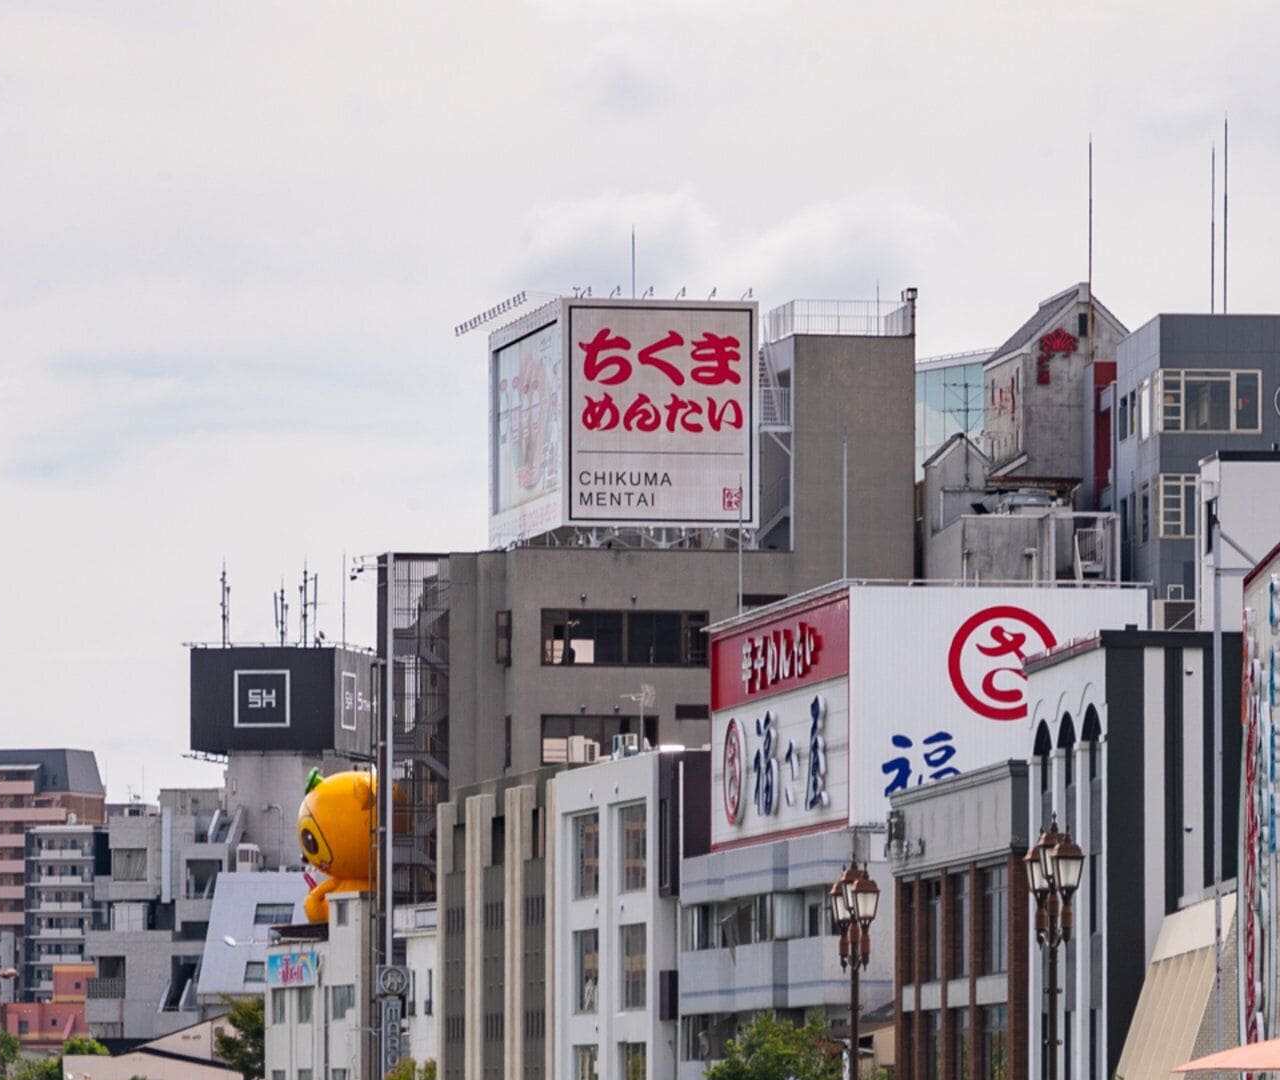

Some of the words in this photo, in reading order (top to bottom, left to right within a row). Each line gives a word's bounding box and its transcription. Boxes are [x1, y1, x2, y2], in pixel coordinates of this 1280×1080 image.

[578, 327, 743, 387] ちくま
[580, 393, 745, 433] めんたい
[578, 470, 673, 487] CHIKUMA
[579, 492, 656, 507] MENTAI
[753, 695, 826, 817] 福さ屋
